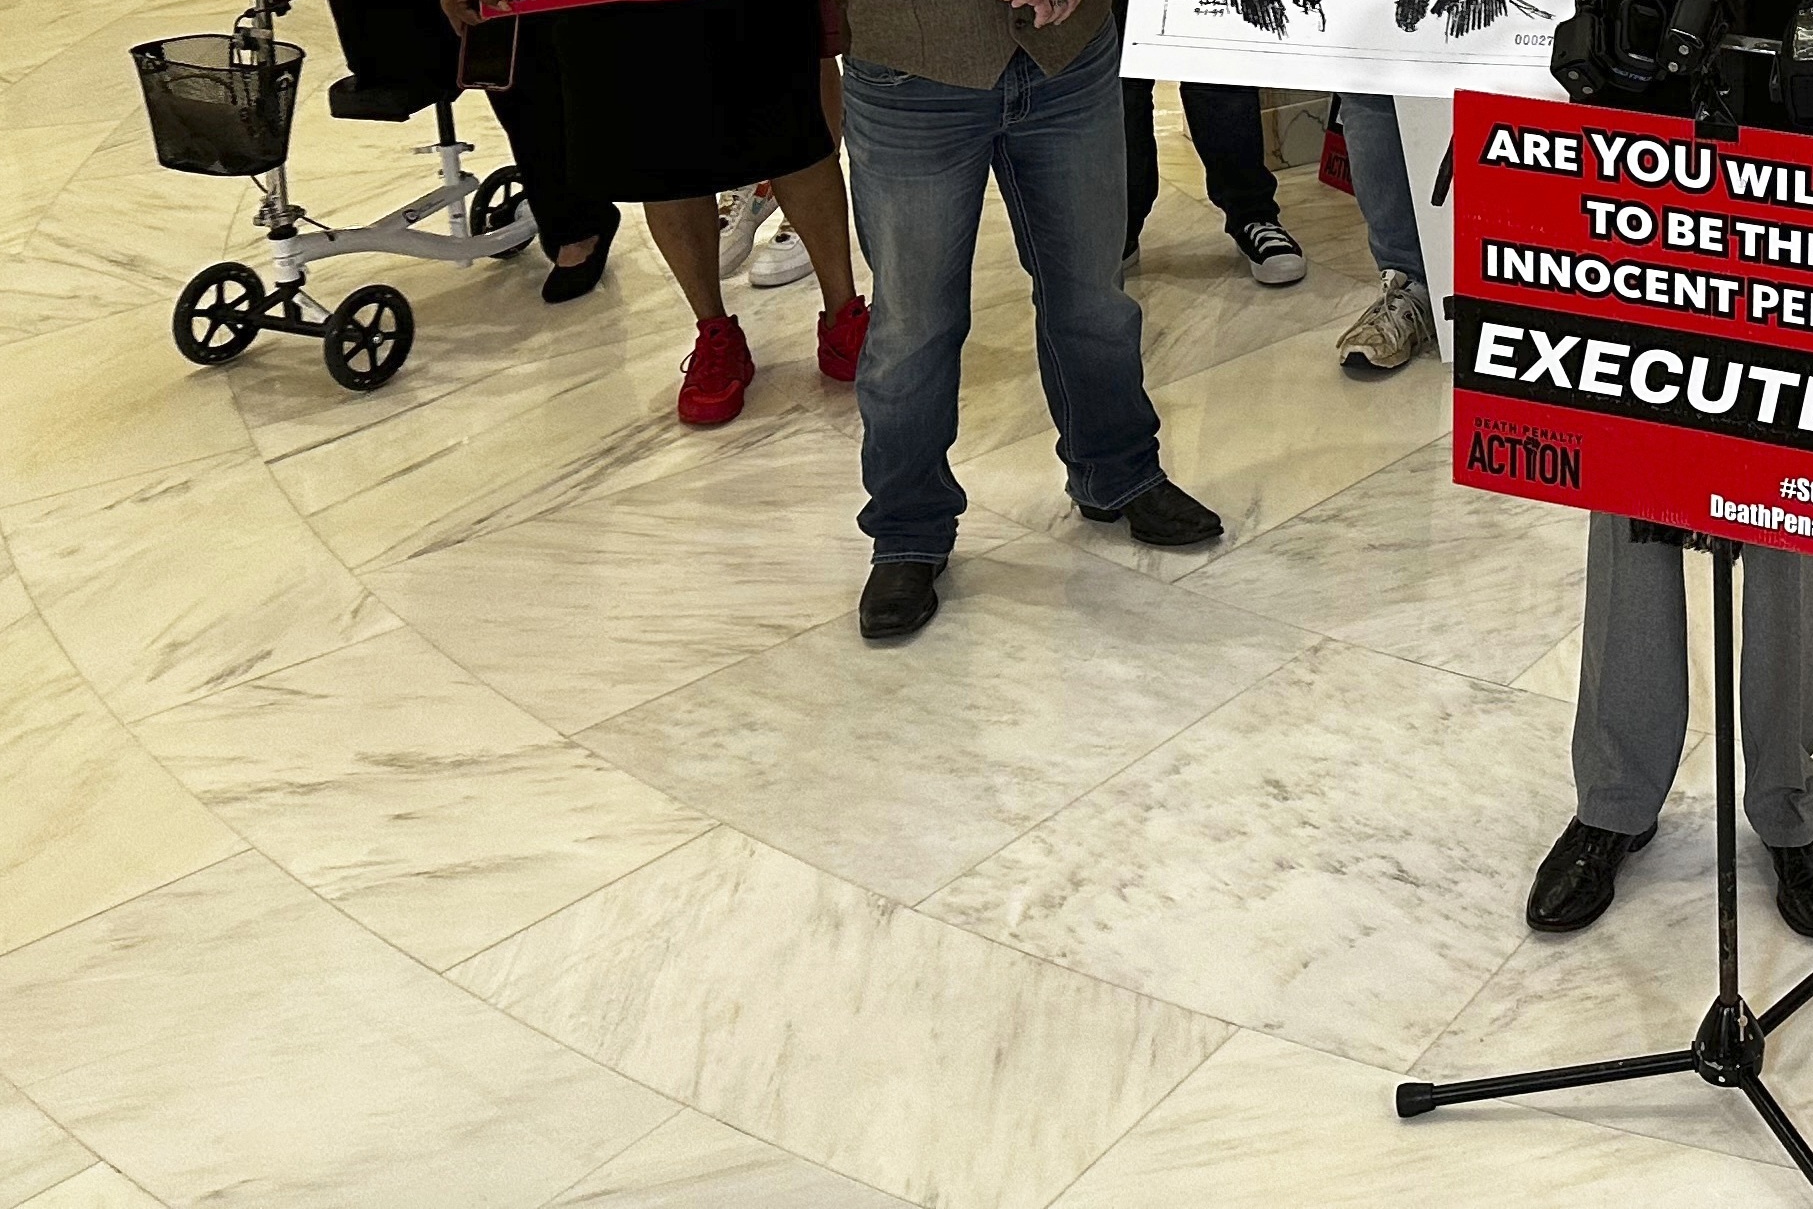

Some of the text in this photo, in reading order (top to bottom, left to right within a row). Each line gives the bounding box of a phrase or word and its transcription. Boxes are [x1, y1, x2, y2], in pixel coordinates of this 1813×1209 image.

[1487, 129, 1578, 171] ARE
[1590, 133, 1711, 188] YOU
[1587, 201, 1653, 240] TO
[1668, 213, 1721, 252] BE
[1486, 246, 1738, 312] INNOCENT
[1467, 431, 1580, 489] ACTION
[1474, 417, 1583, 445] DEATH PENALTY
